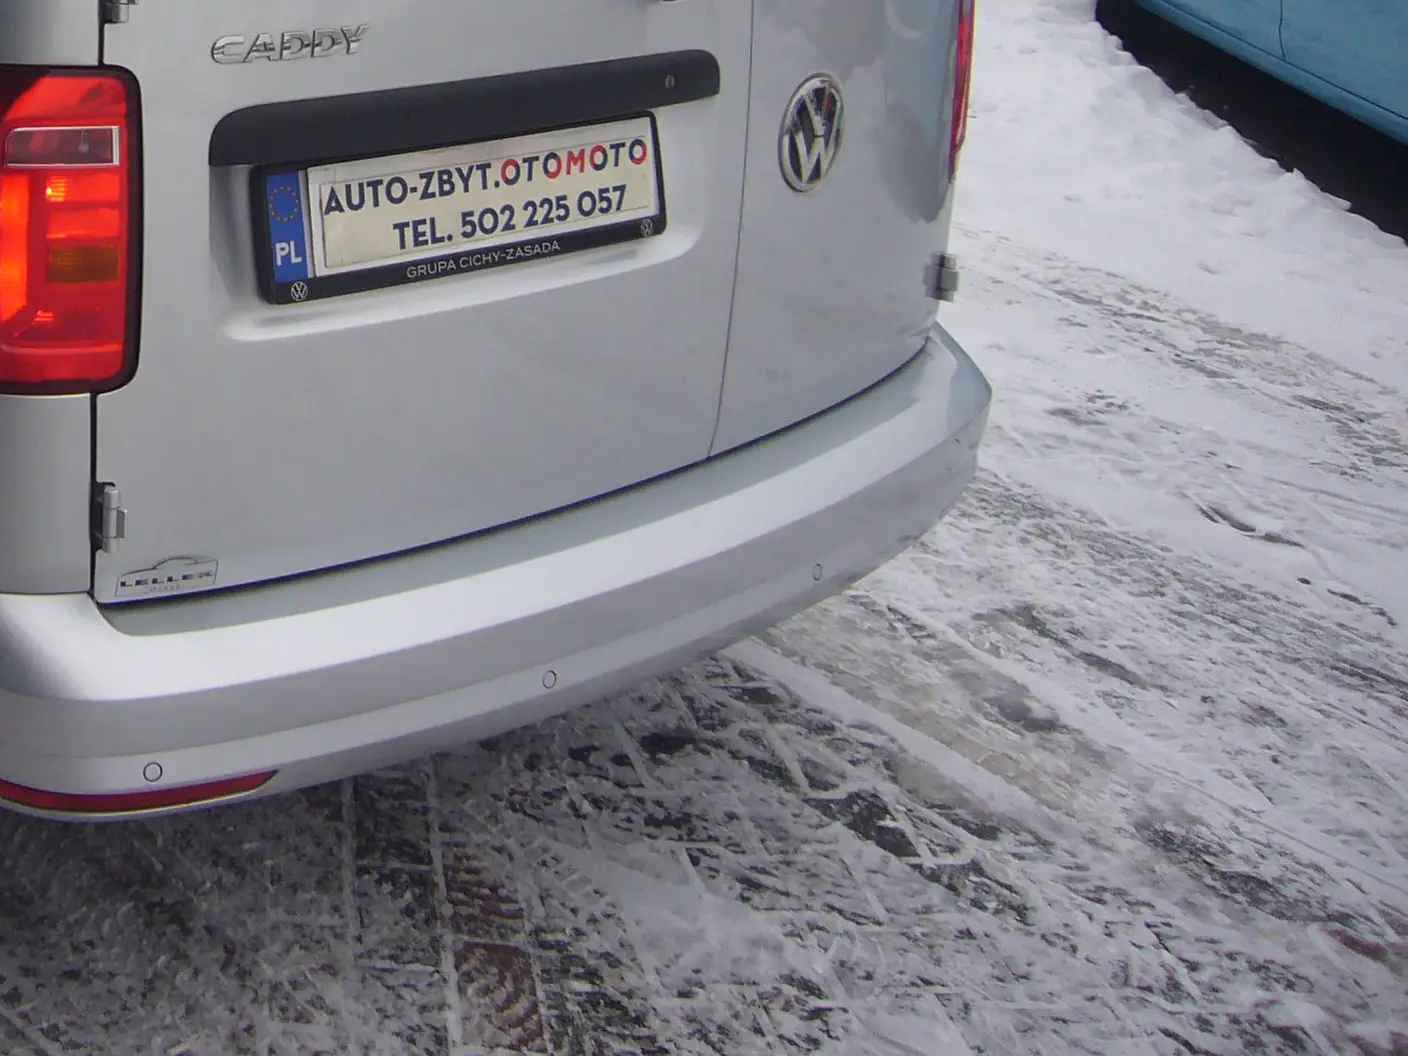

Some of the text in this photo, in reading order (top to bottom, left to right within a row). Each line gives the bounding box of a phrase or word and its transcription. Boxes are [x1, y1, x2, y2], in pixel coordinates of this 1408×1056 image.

[211, 23, 370, 65] CADDY
[323, 138, 648, 216] AUTO-ZBYT.OTOMOTO
[392, 184, 627, 250] TEL. 502 225 057
[275, 241, 302, 266] PL
[406, 240, 561, 278] GRUPA CICHY-ZASADA
